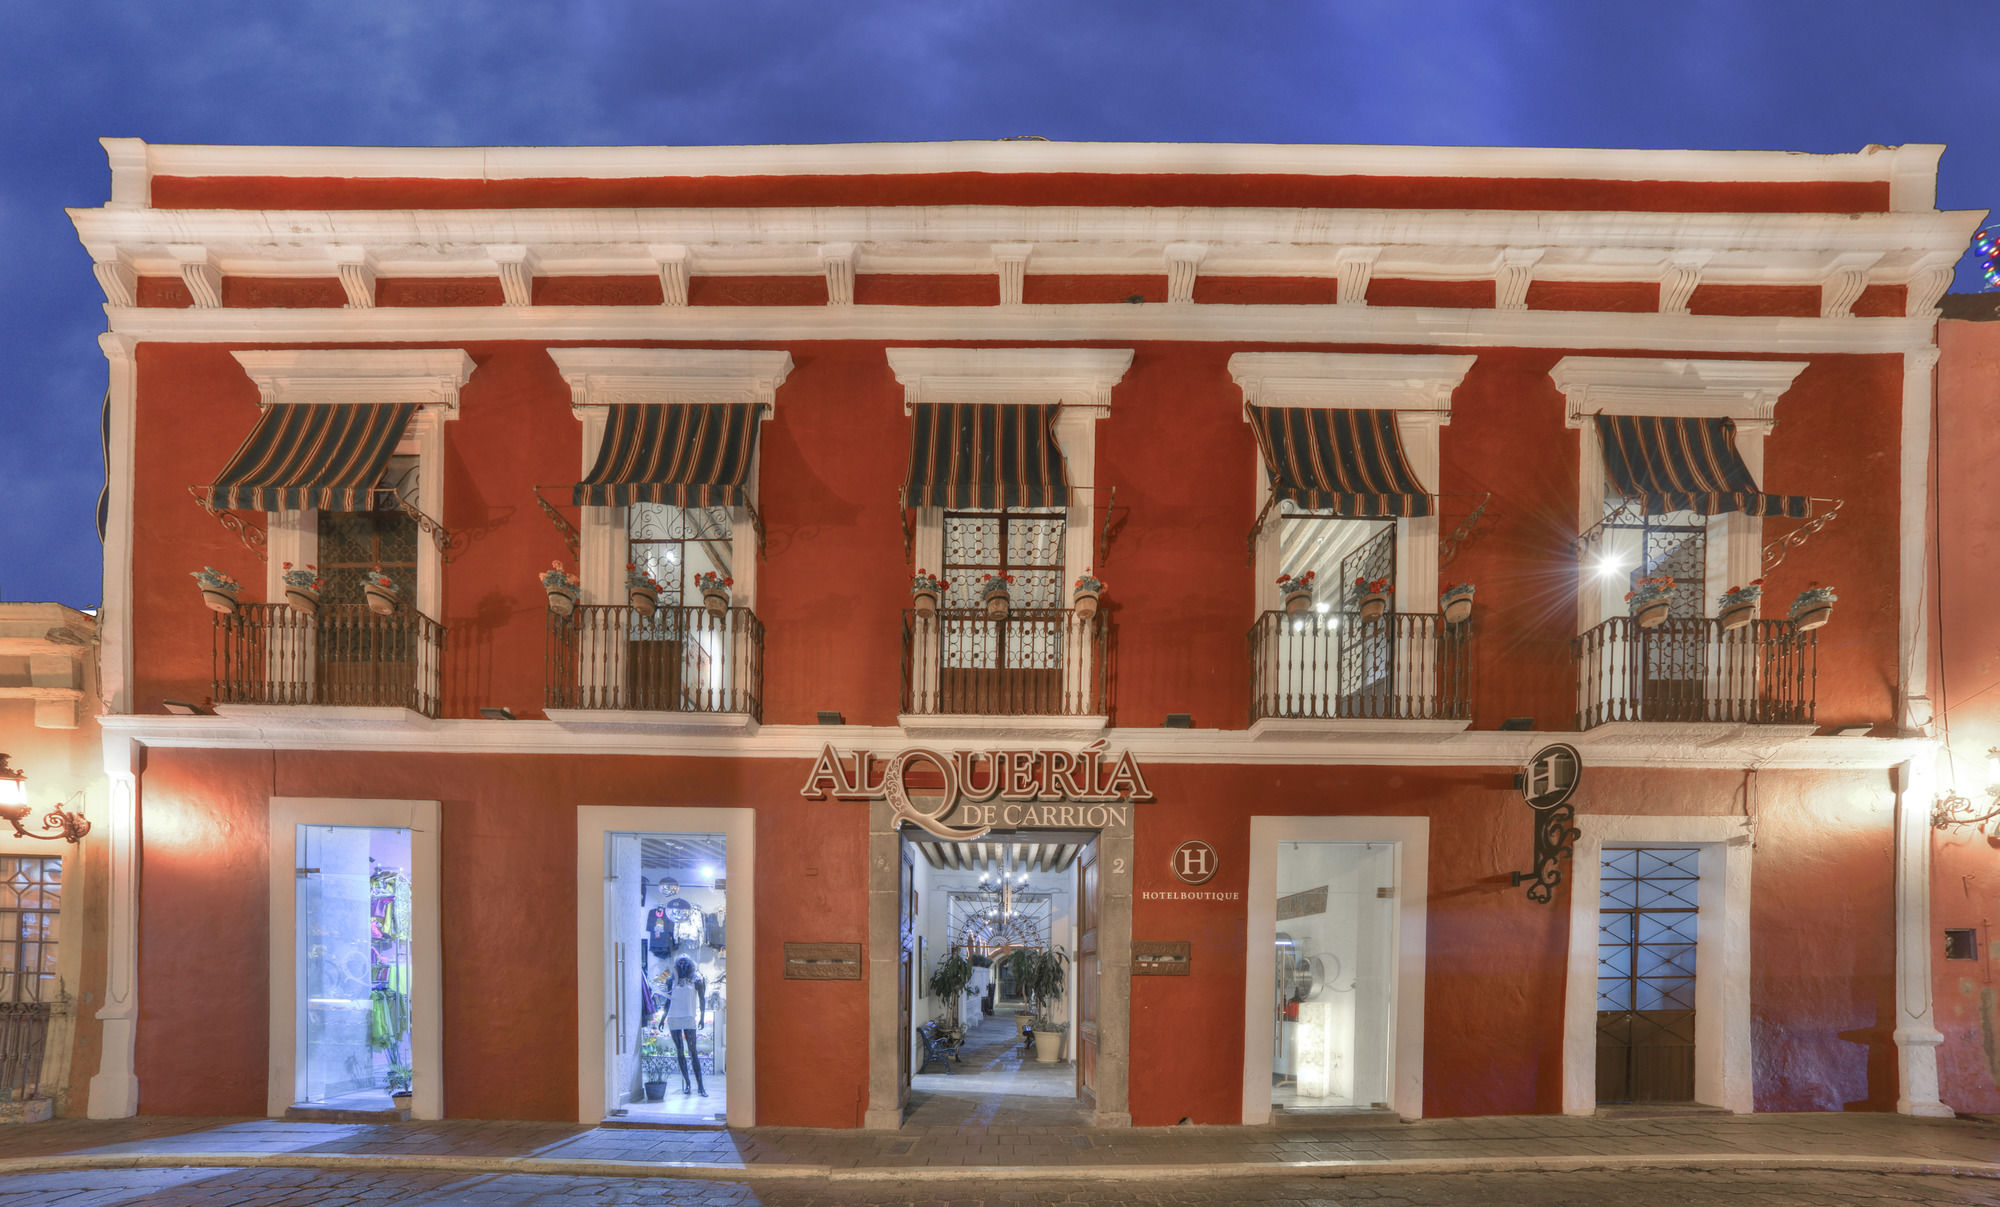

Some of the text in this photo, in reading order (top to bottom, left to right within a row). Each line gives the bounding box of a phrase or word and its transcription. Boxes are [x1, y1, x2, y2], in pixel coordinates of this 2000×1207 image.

[800, 738, 1153, 840] ALQUERÍA
[1524, 753, 1561, 801] H
[961, 804, 1128, 827] DE CARRIÓN
[1112, 858, 1125, 874] 2
[1180, 848, 1209, 875] H
